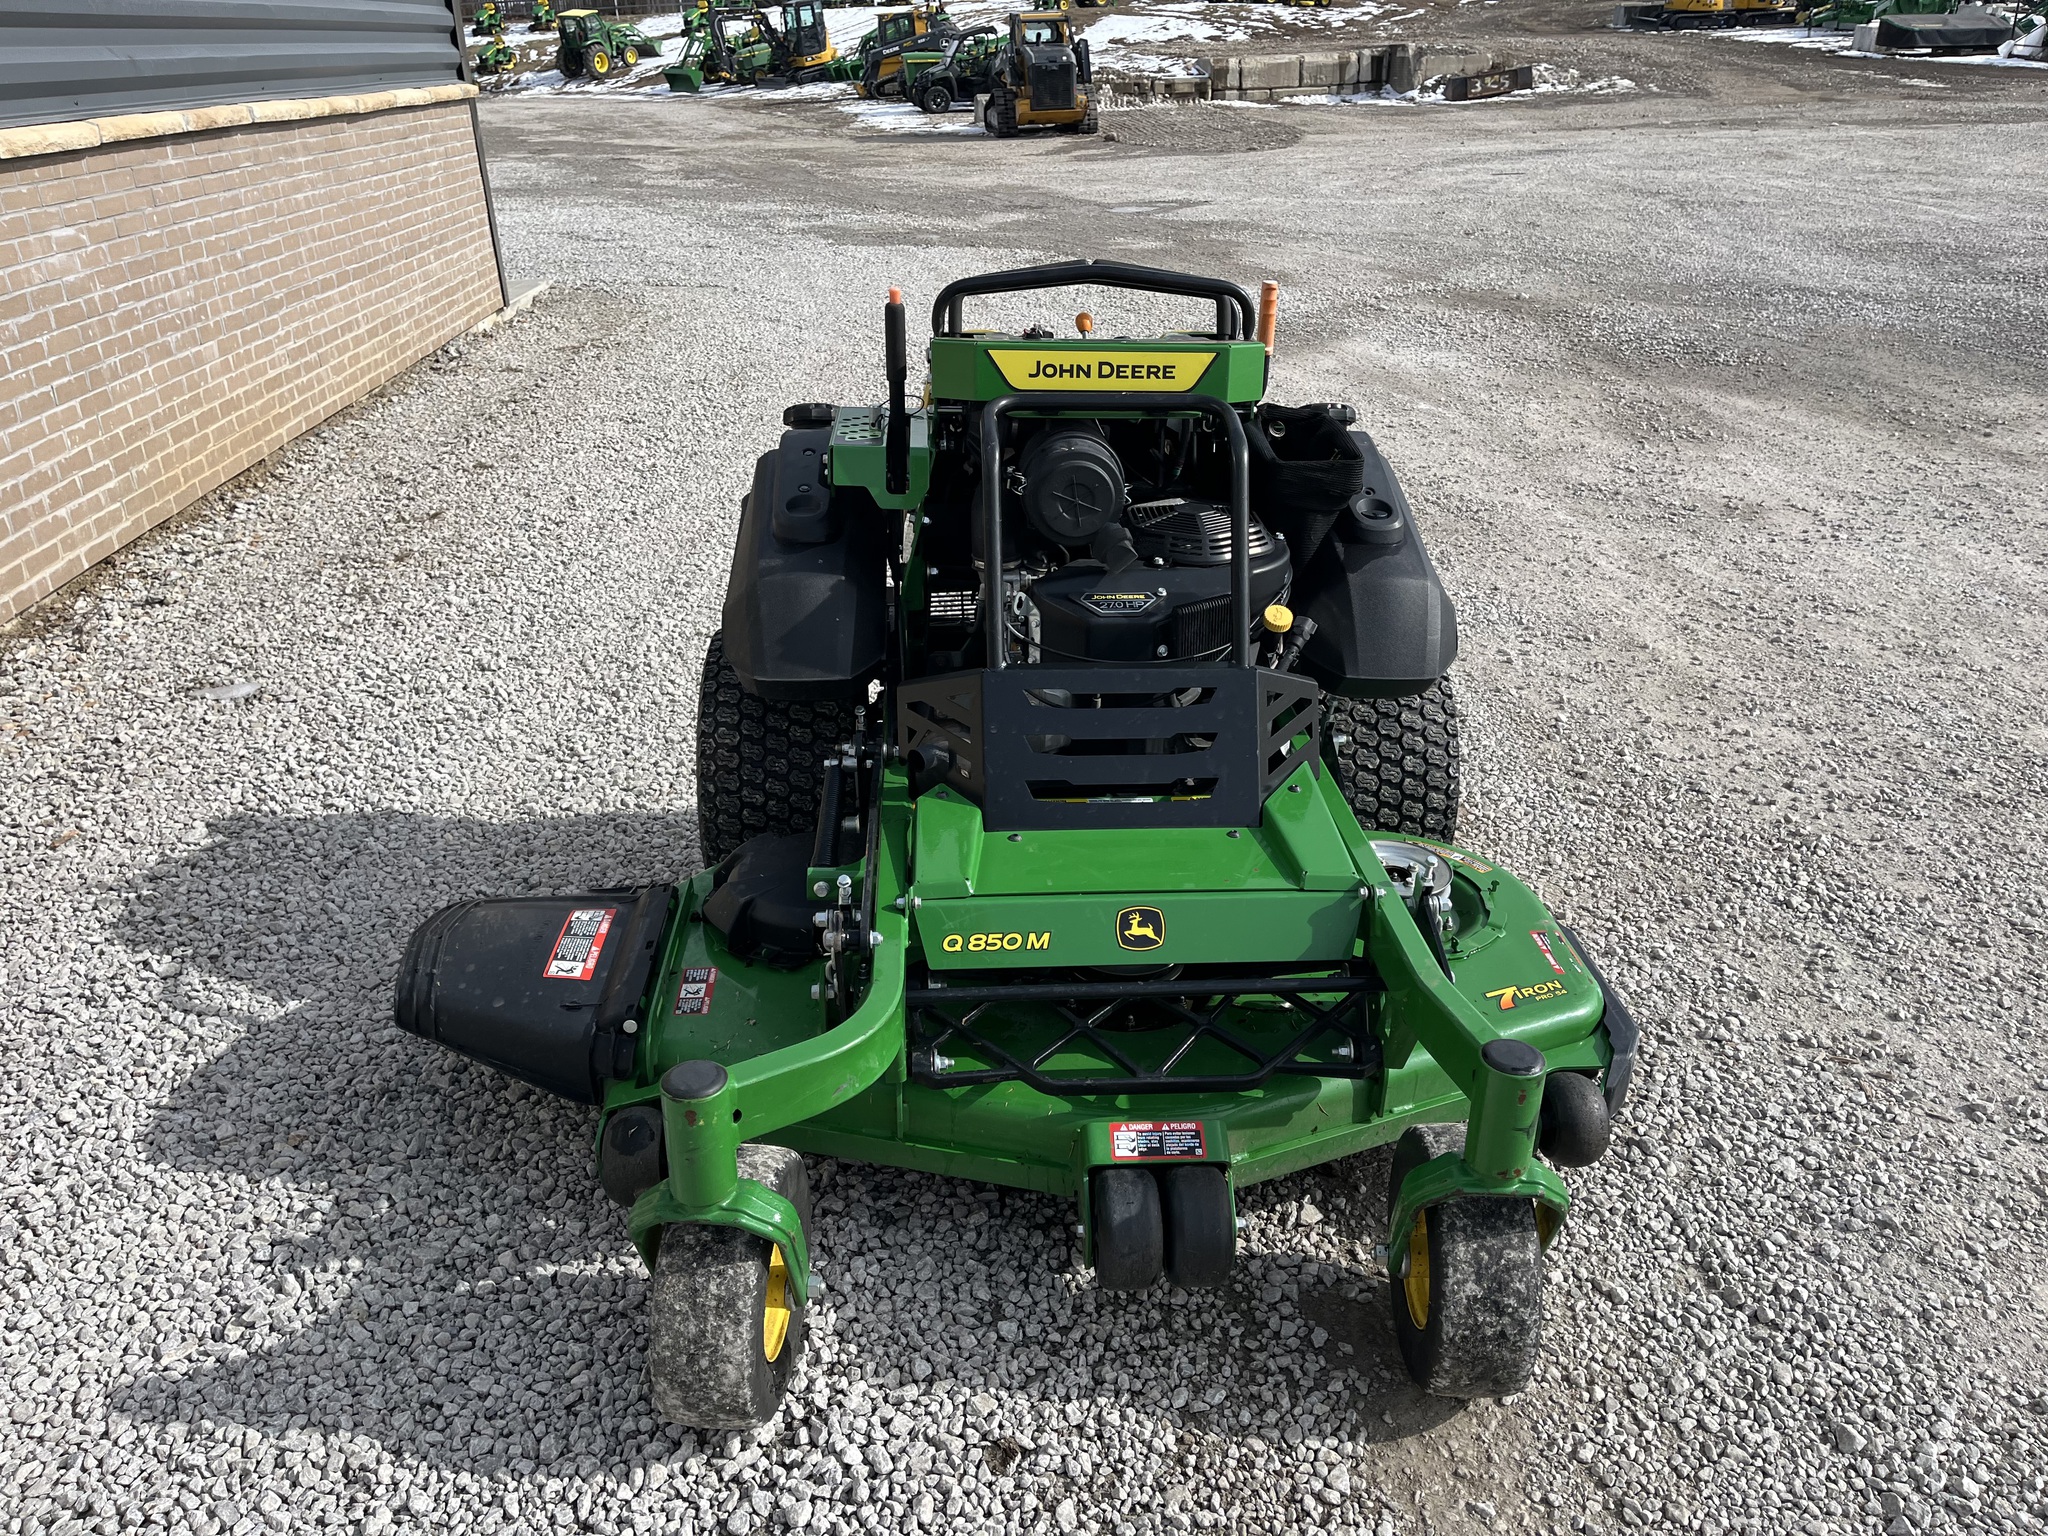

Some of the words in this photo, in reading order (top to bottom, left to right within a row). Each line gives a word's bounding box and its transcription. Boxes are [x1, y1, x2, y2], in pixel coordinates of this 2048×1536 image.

[882, 46, 900, 54] DEERE
[1028, 360, 1091, 379] JOHN
[1098, 361, 1176, 380] DEERE
[942, 934, 962, 952] Q
[967, 932, 1023, 952] 850
[1026, 932, 1051, 951] M
[1535, 993, 1554, 1001] PRO
